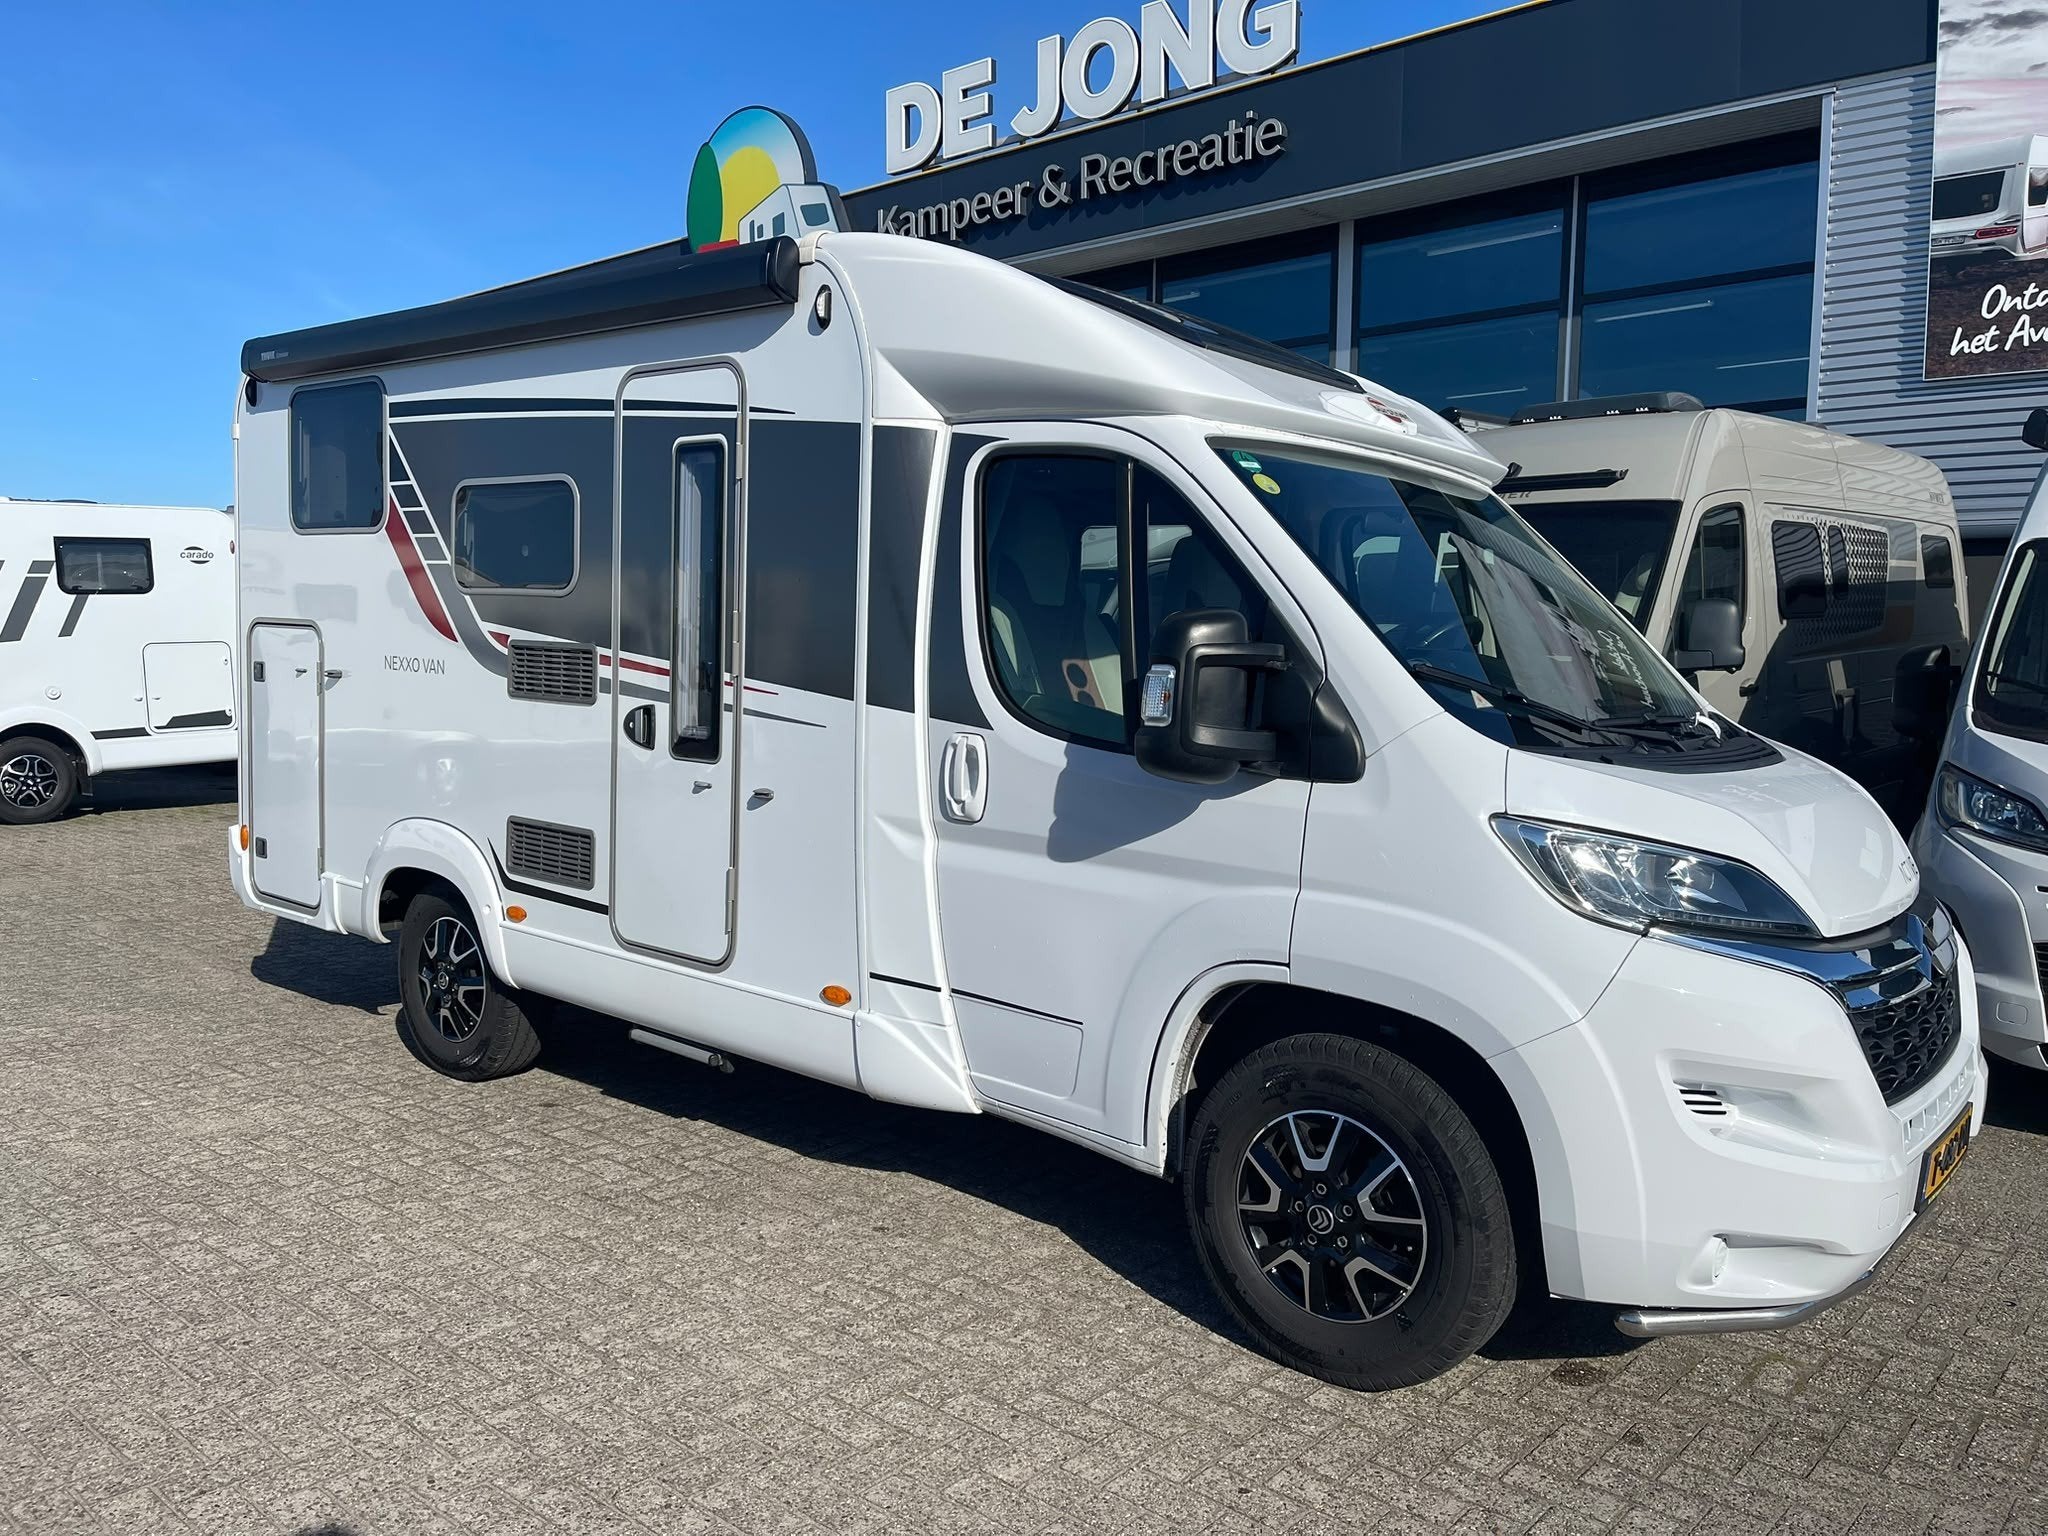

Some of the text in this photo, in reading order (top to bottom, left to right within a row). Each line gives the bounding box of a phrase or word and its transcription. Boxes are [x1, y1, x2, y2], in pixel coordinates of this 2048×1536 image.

[886, 0, 1301, 174] DE JONG
[877, 110, 1289, 241] Kampeer & Recreatie
[1949, 325, 2001, 357] het
[179, 550, 215, 559] carado
[384, 655, 446, 675] NEXXO VAN
